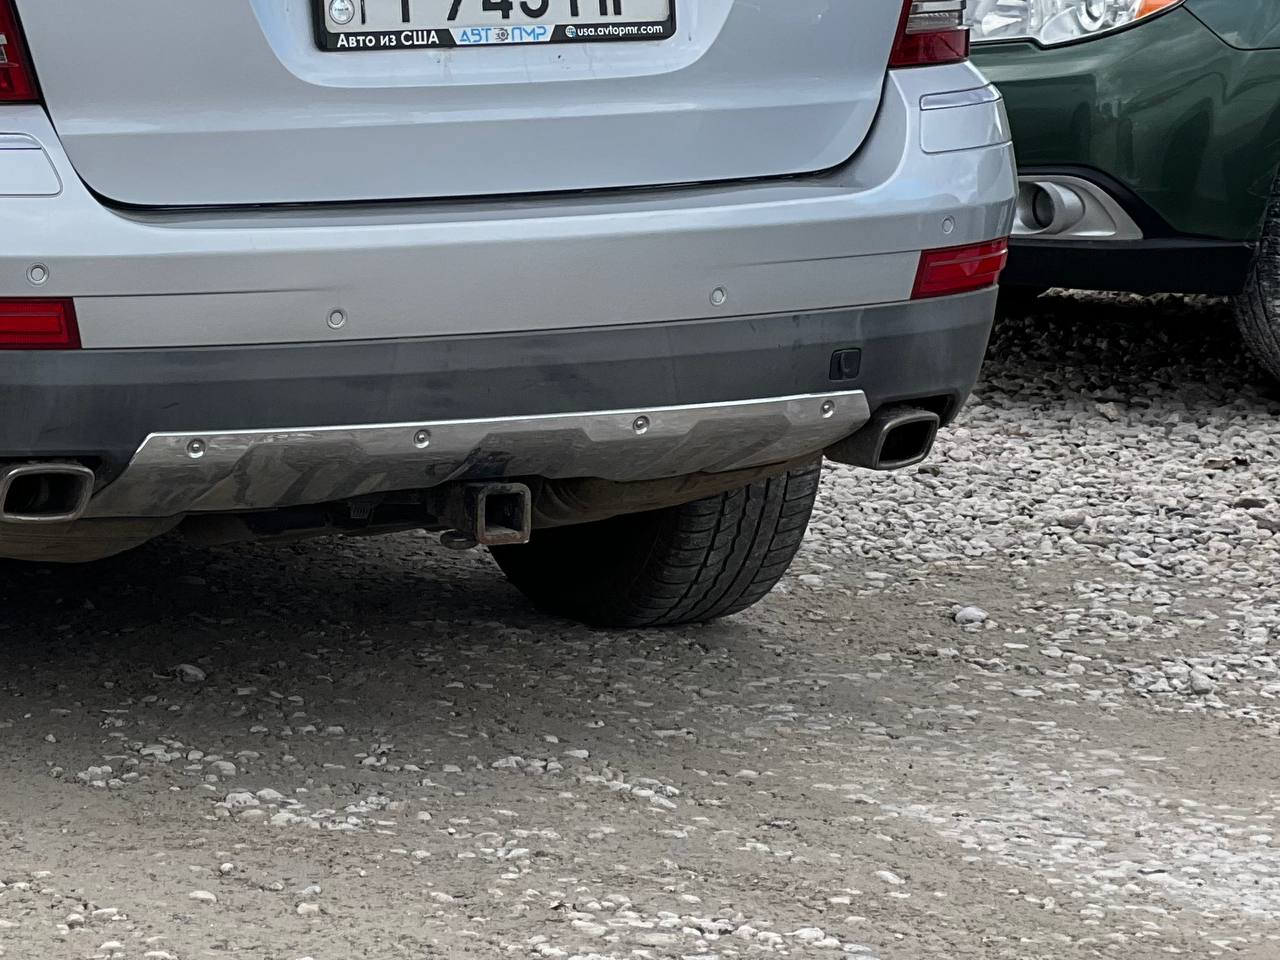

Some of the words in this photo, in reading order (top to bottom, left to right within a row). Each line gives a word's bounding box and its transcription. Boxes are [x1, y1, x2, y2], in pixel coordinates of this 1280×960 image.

[577, 24, 664, 37] usa.avtopmr.com
[337, 33, 376, 48] Авто
[380, 34, 397, 46] из
[401, 30, 440, 46] США
